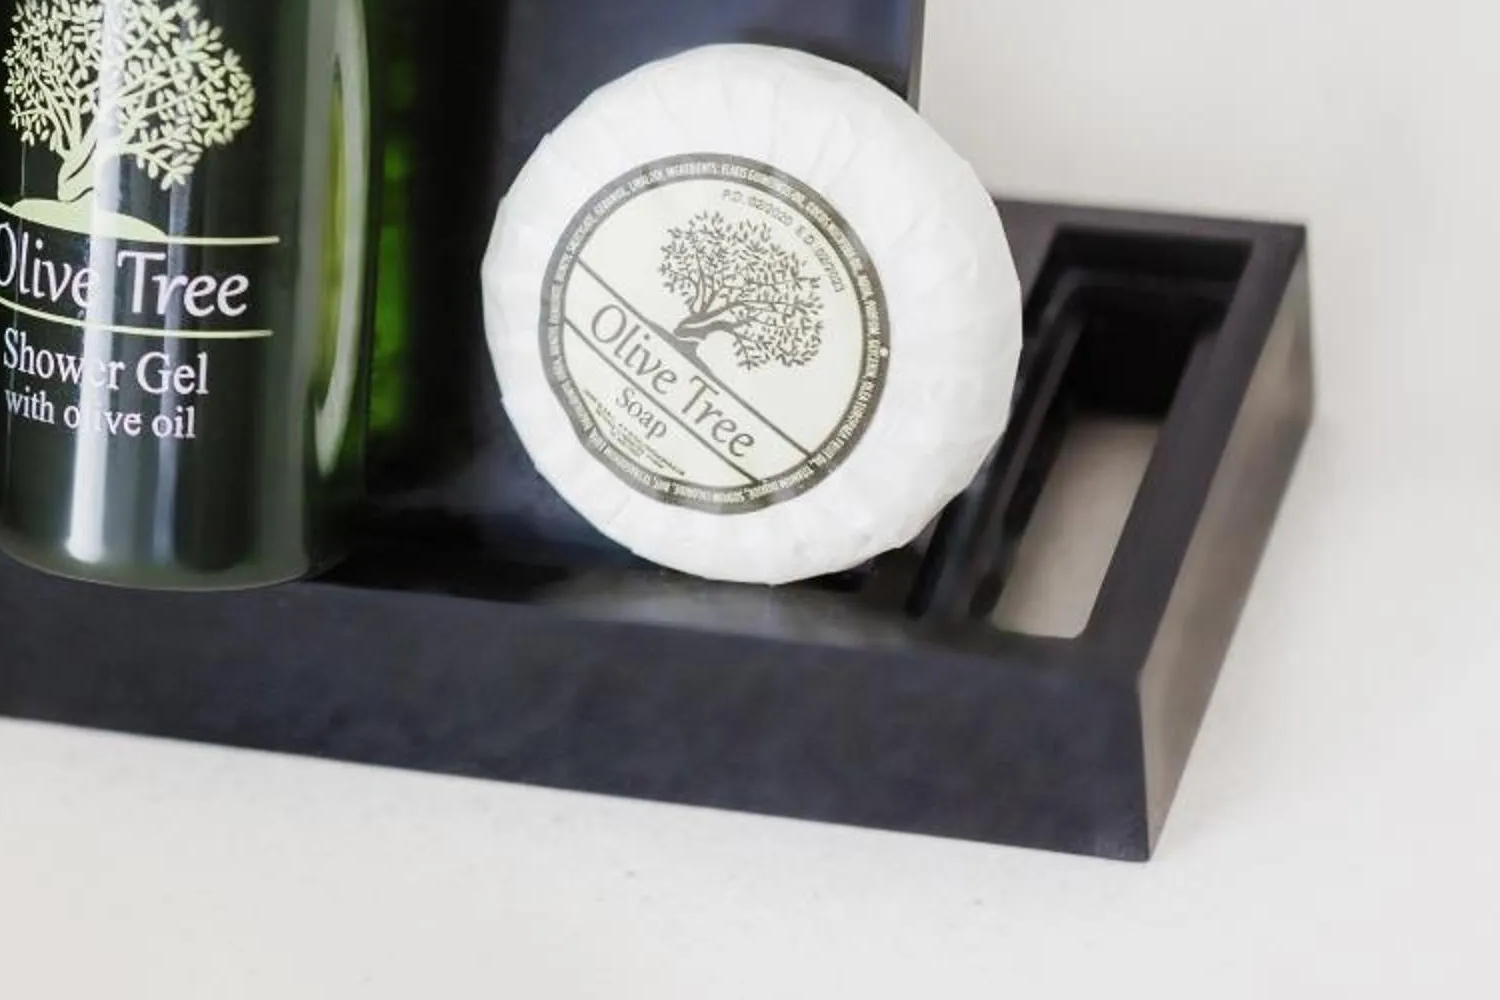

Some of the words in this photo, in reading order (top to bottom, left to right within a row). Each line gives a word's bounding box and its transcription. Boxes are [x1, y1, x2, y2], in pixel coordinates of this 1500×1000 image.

[116, 250, 250, 318] Tree
[2, 327, 126, 391] Shower
[136, 350, 210, 396] Gel
[591, 303, 678, 395] Olive
[681, 375, 756, 457] Tree
[4, 385, 55, 425] with
[151, 405, 197, 439] oil
[615, 386, 668, 439] Soap
